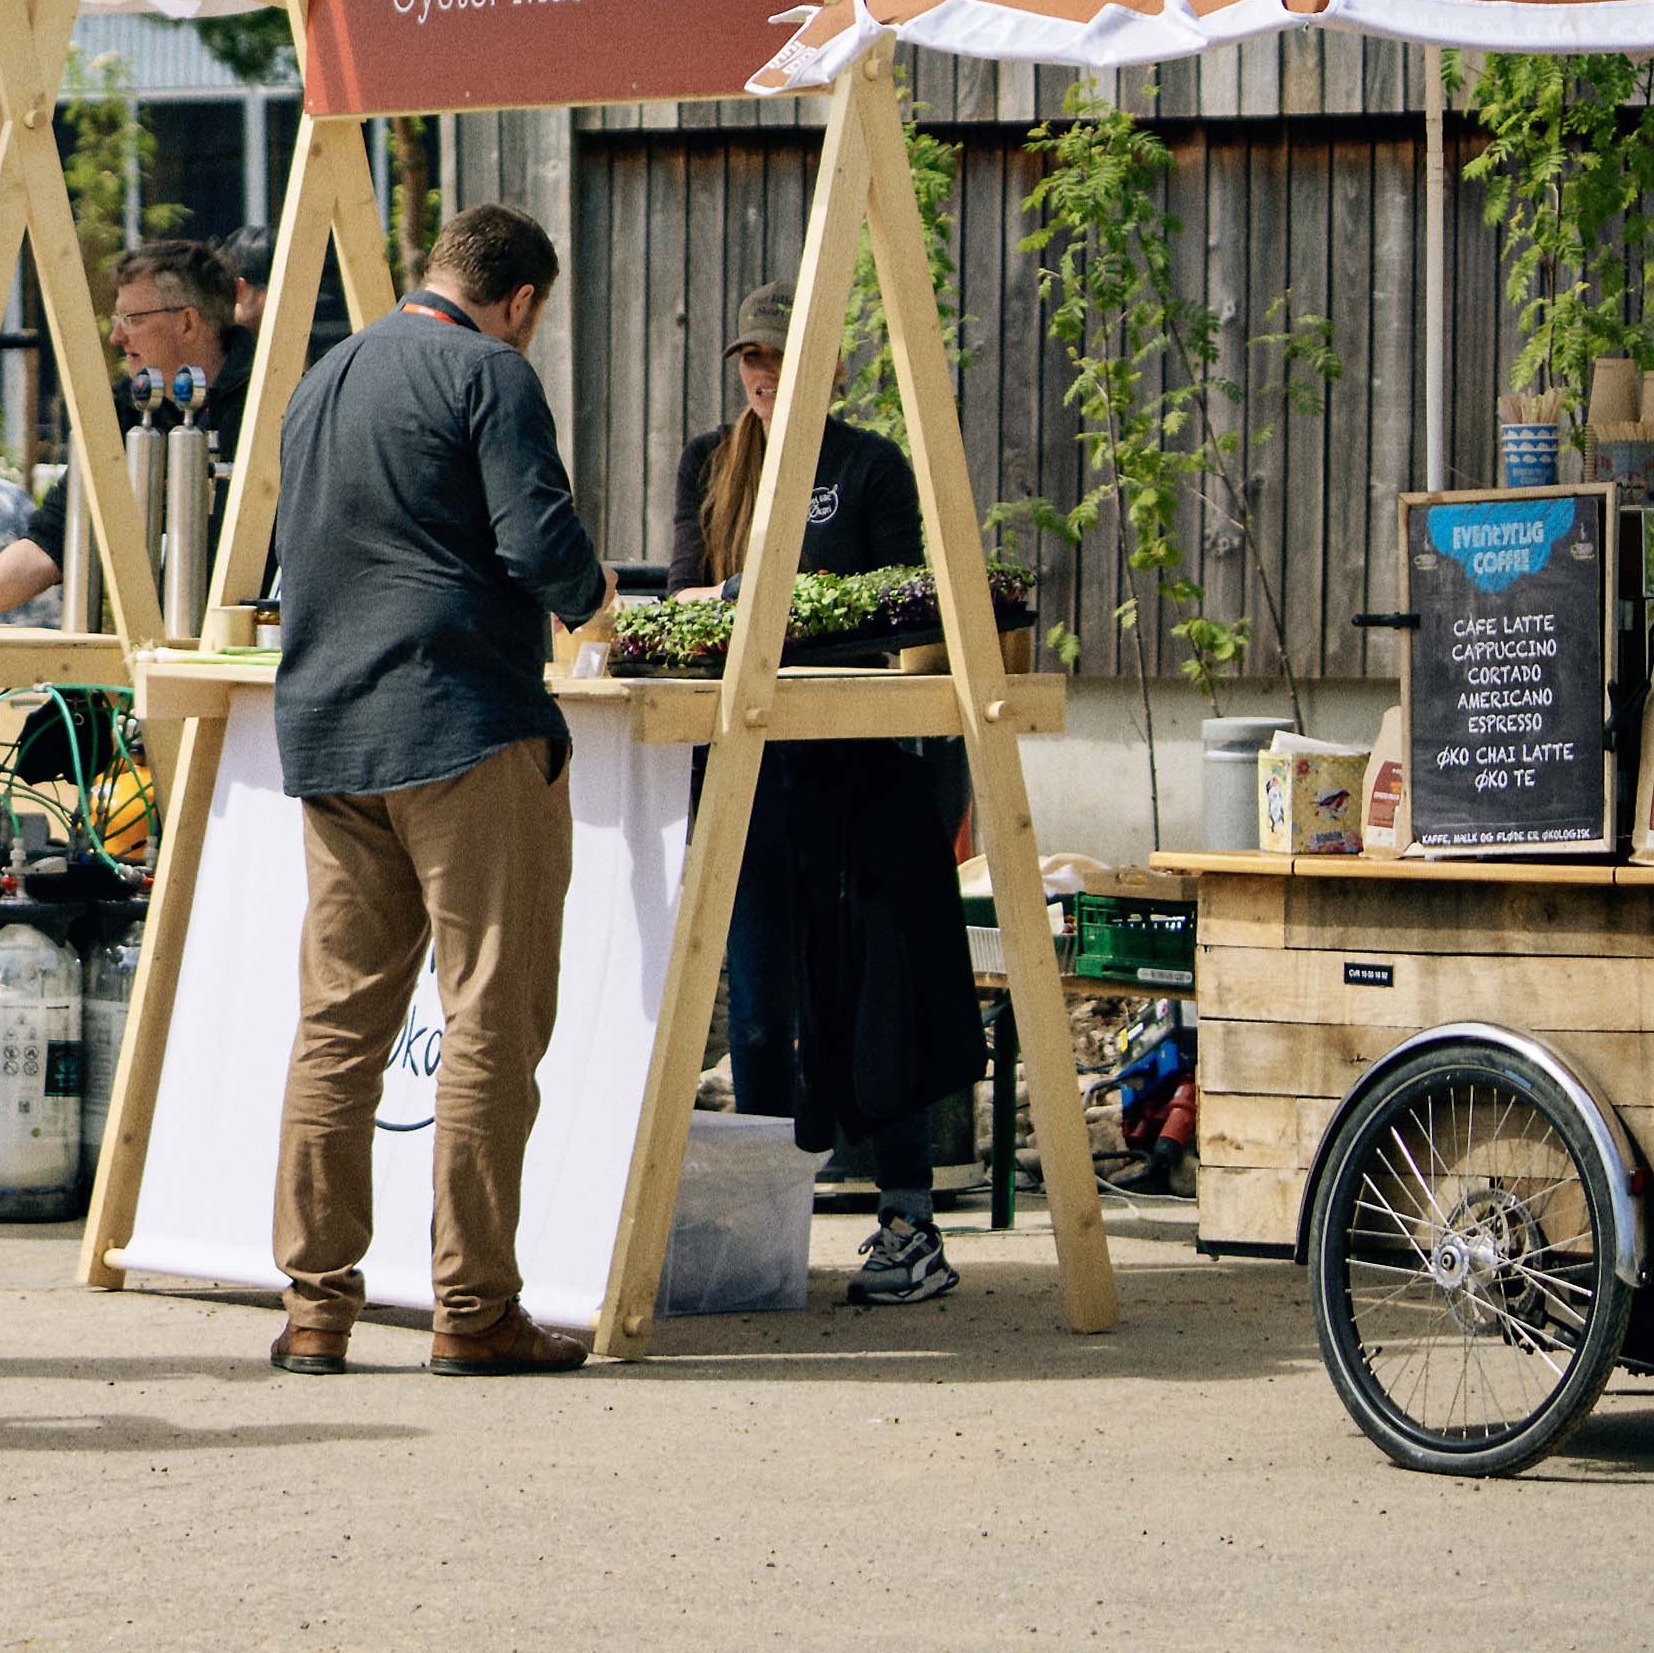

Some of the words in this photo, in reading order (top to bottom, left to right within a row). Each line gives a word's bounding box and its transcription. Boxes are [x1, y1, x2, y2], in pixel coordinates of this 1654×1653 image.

[1473, 548, 1531, 574] COFFEE
[1453, 618, 1497, 637] CAFE
[1503, 615, 1555, 634] LATTE
[1452, 638, 1557, 661] CAPPUCCINO
[1468, 664, 1542, 685] CORTADO
[1457, 688, 1553, 709] AMERICANO
[1468, 712, 1542, 733] ESPRESSO
[1436, 746, 1469, 769] ØKO
[1476, 746, 1516, 764] CHAI
[1523, 742, 1574, 762] LATTE
[1475, 768, 1508, 792] ØKO
[1514, 769, 1535, 787] TE
[1481, 832, 1494, 843] OG
[1528, 830, 1539, 841] ER
